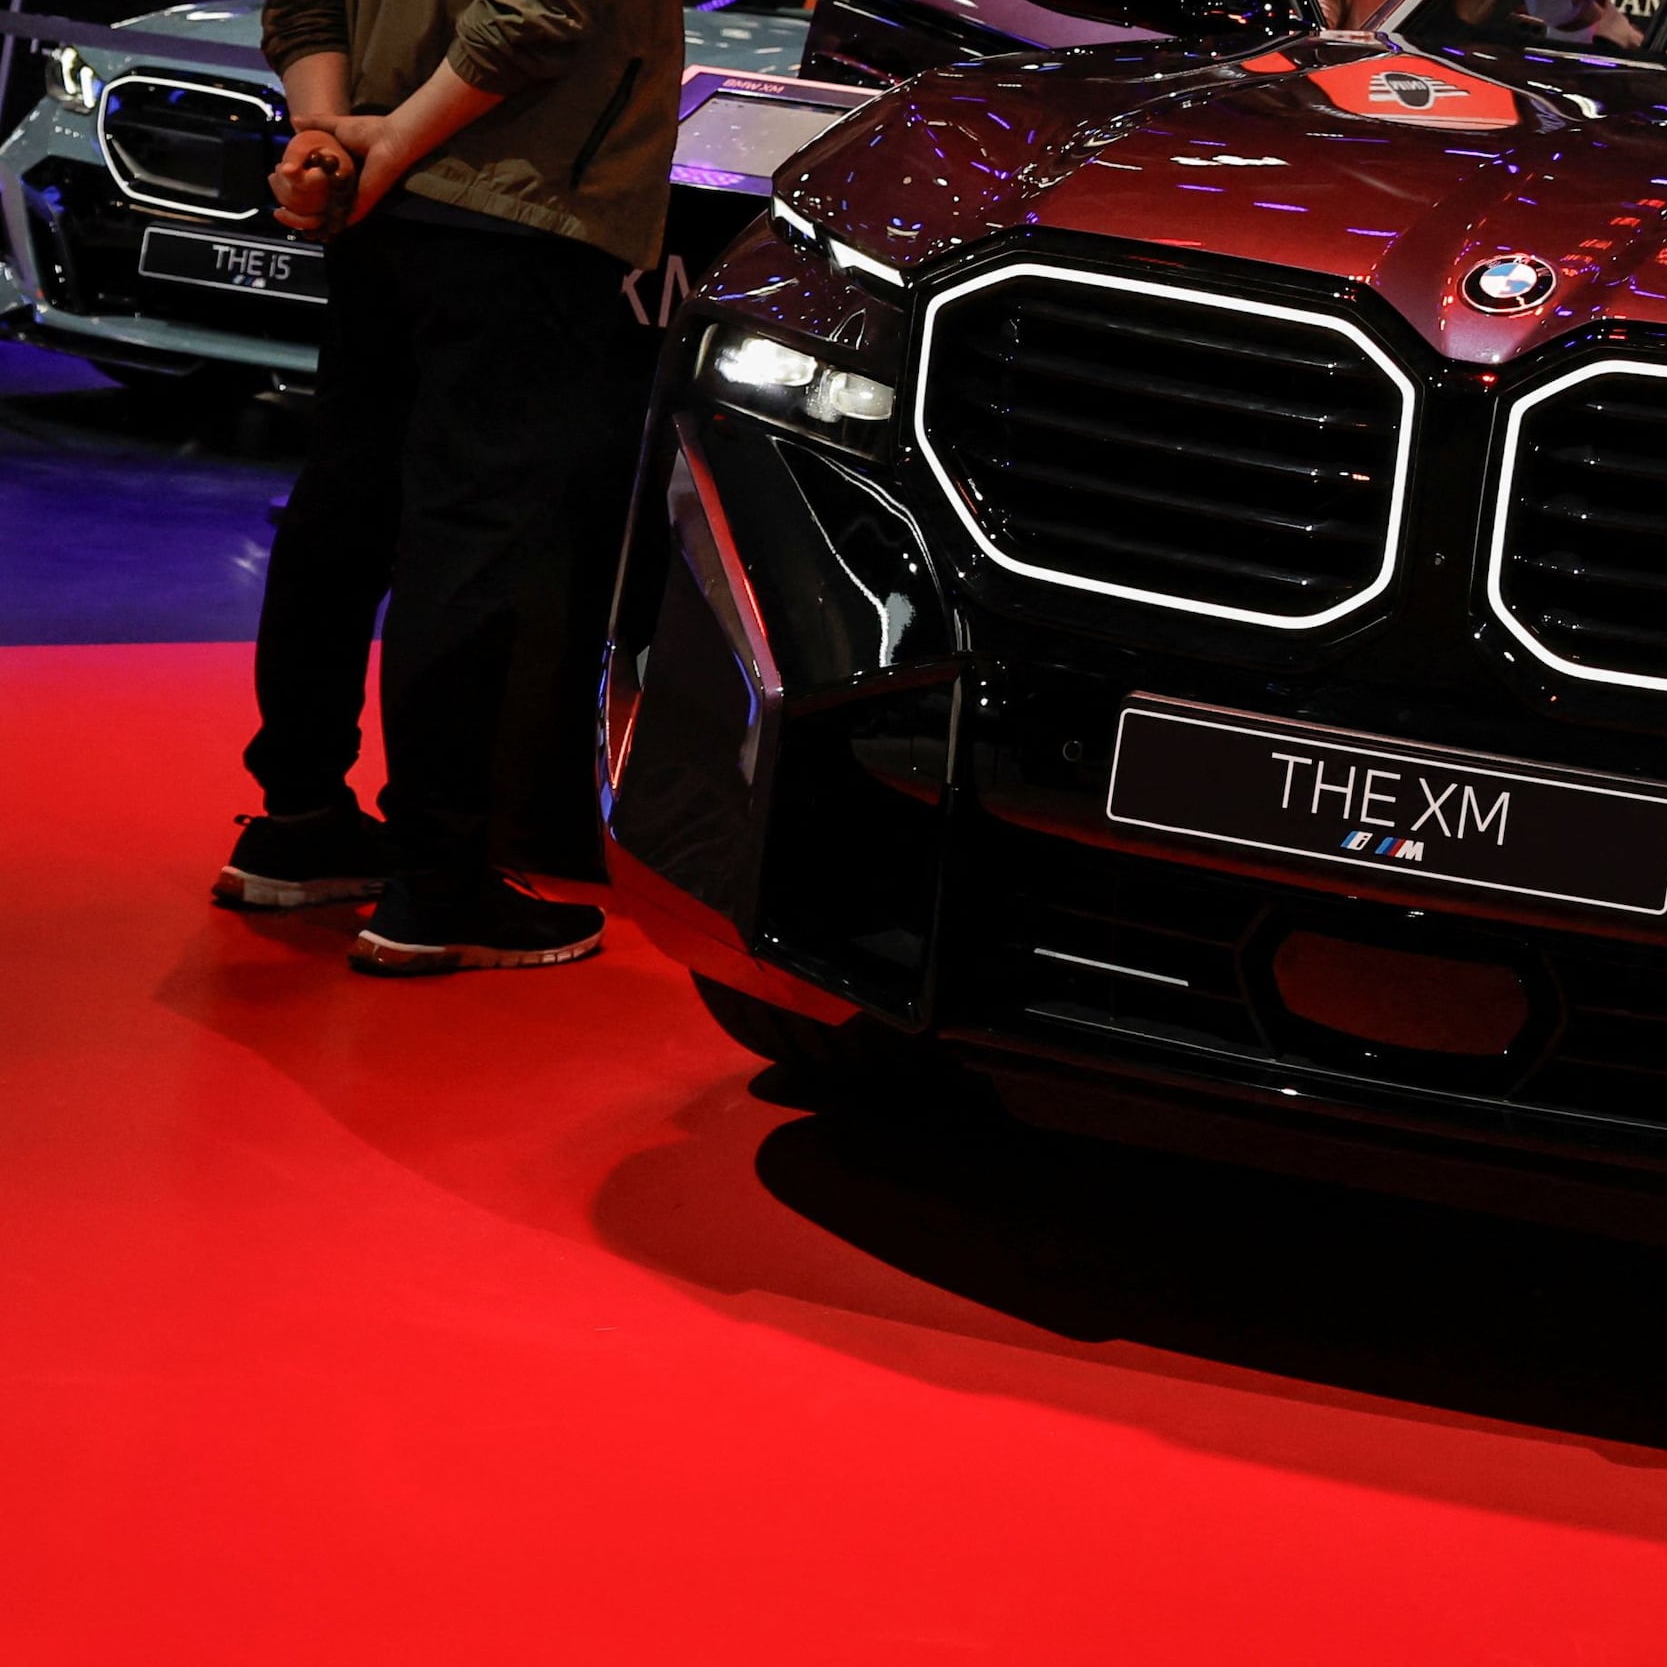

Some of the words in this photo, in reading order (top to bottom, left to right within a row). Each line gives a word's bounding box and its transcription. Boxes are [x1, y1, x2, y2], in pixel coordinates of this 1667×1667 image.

[213, 245, 265, 275] THE
[1271, 751, 1401, 828] THE
[1409, 776, 1512, 847] XM
